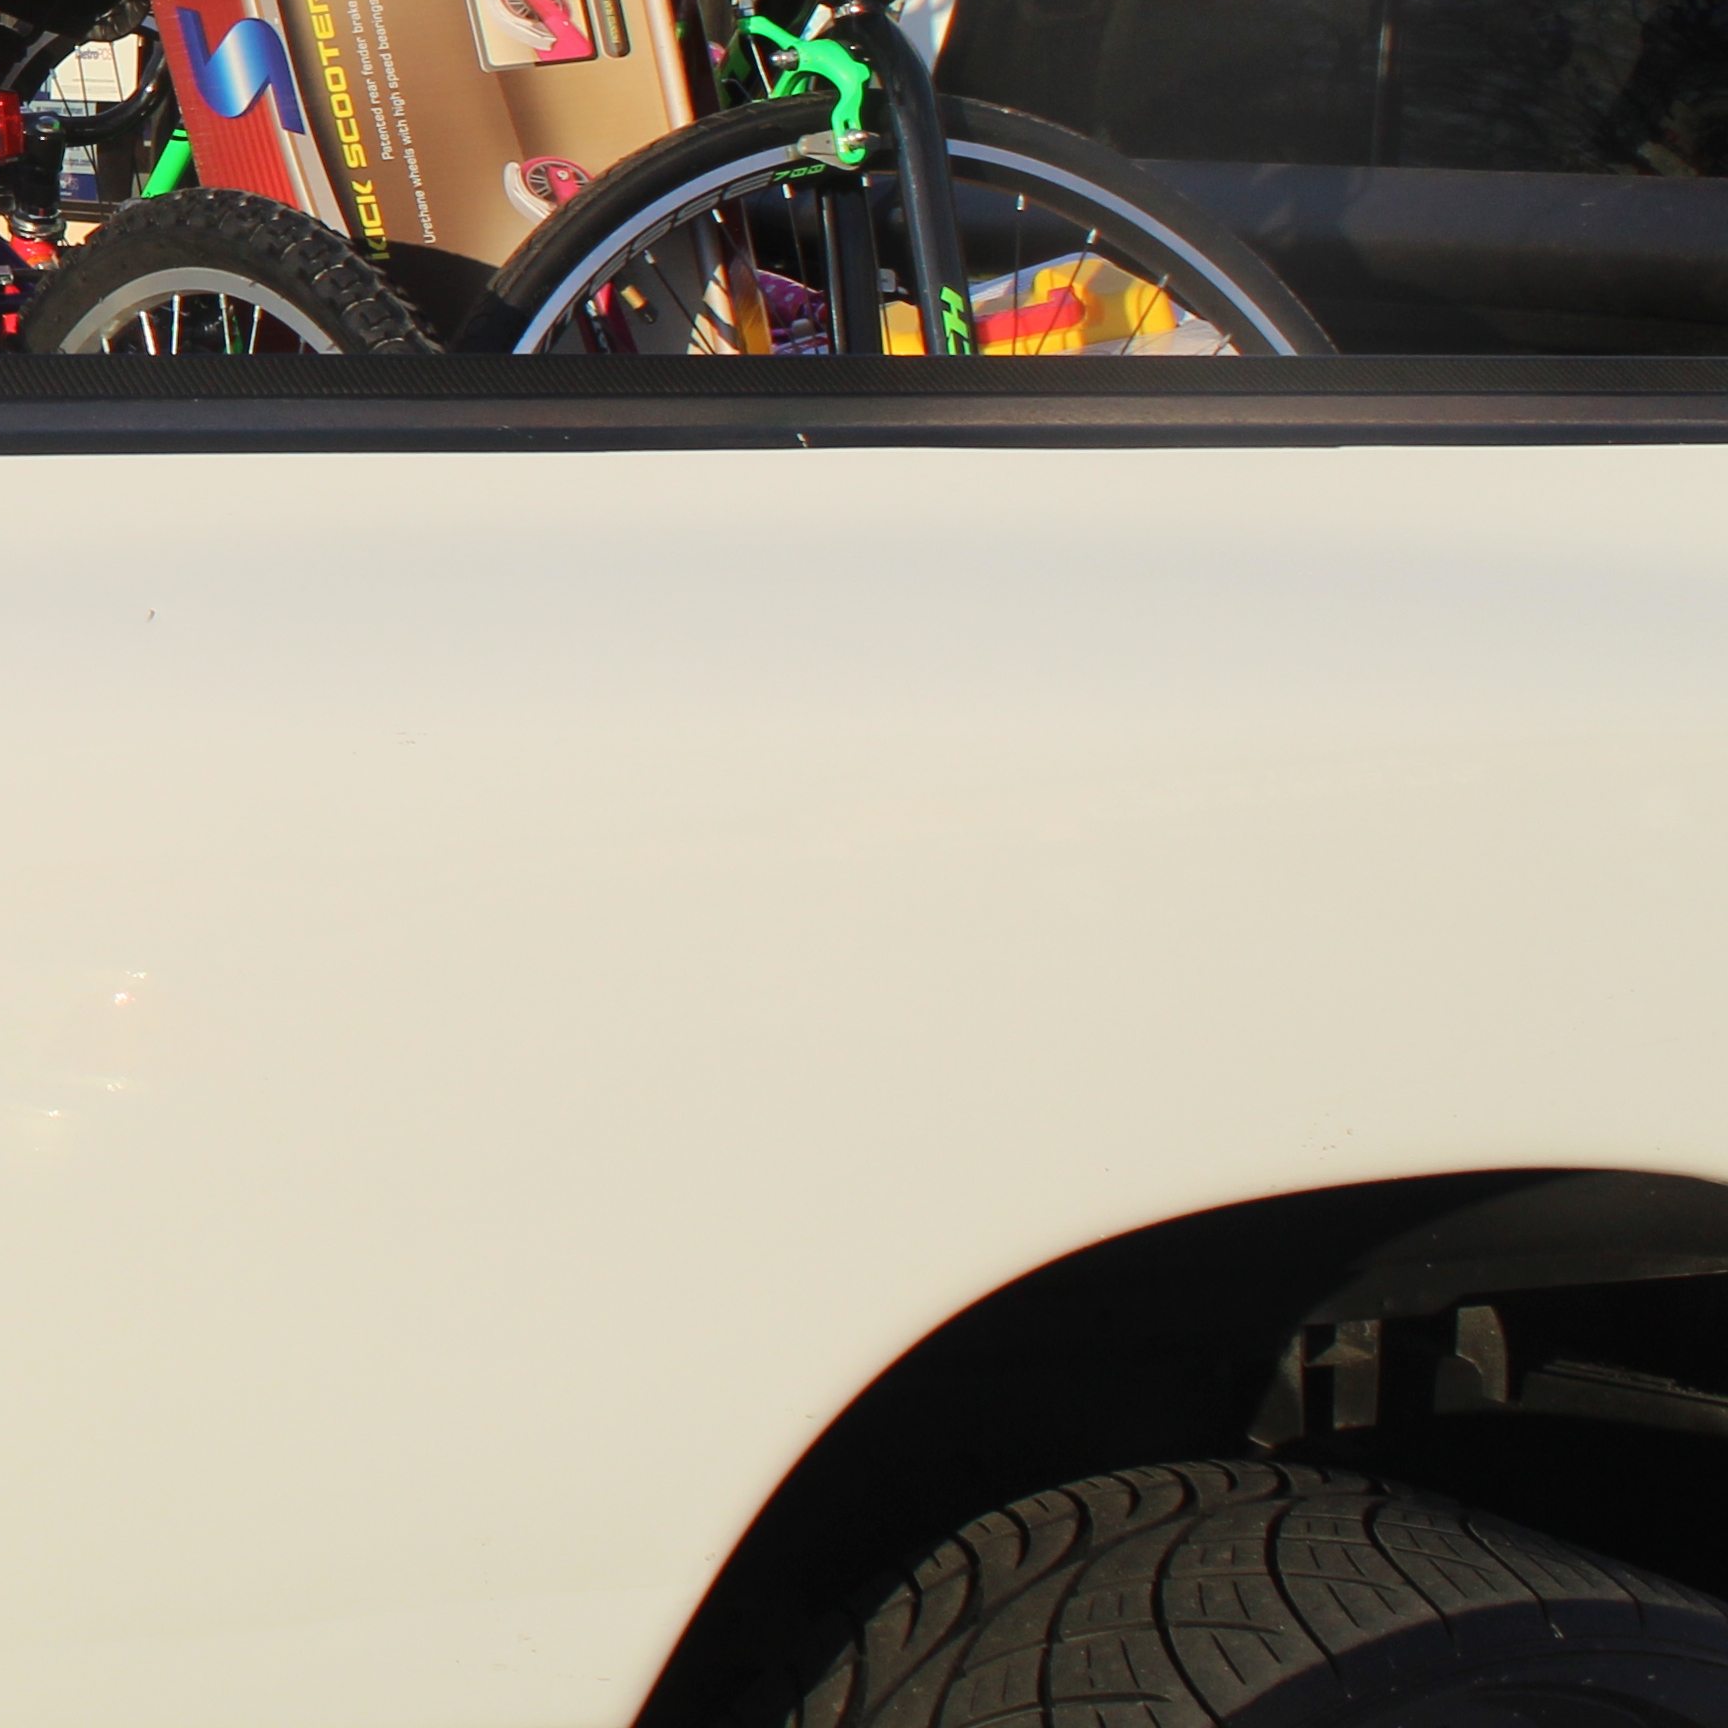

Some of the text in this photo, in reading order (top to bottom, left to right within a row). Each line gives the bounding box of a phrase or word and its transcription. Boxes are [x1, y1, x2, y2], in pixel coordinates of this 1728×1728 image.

[346, 0, 394, 161] Patented rear fender brake
[378, 53, 400, 90] speed
[389, 91, 406, 117] high
[395, 119, 414, 146] with
[403, 147, 424, 188] wheels
[351, 179, 391, 261] KICK
[414, 190, 437, 244] Urethane
